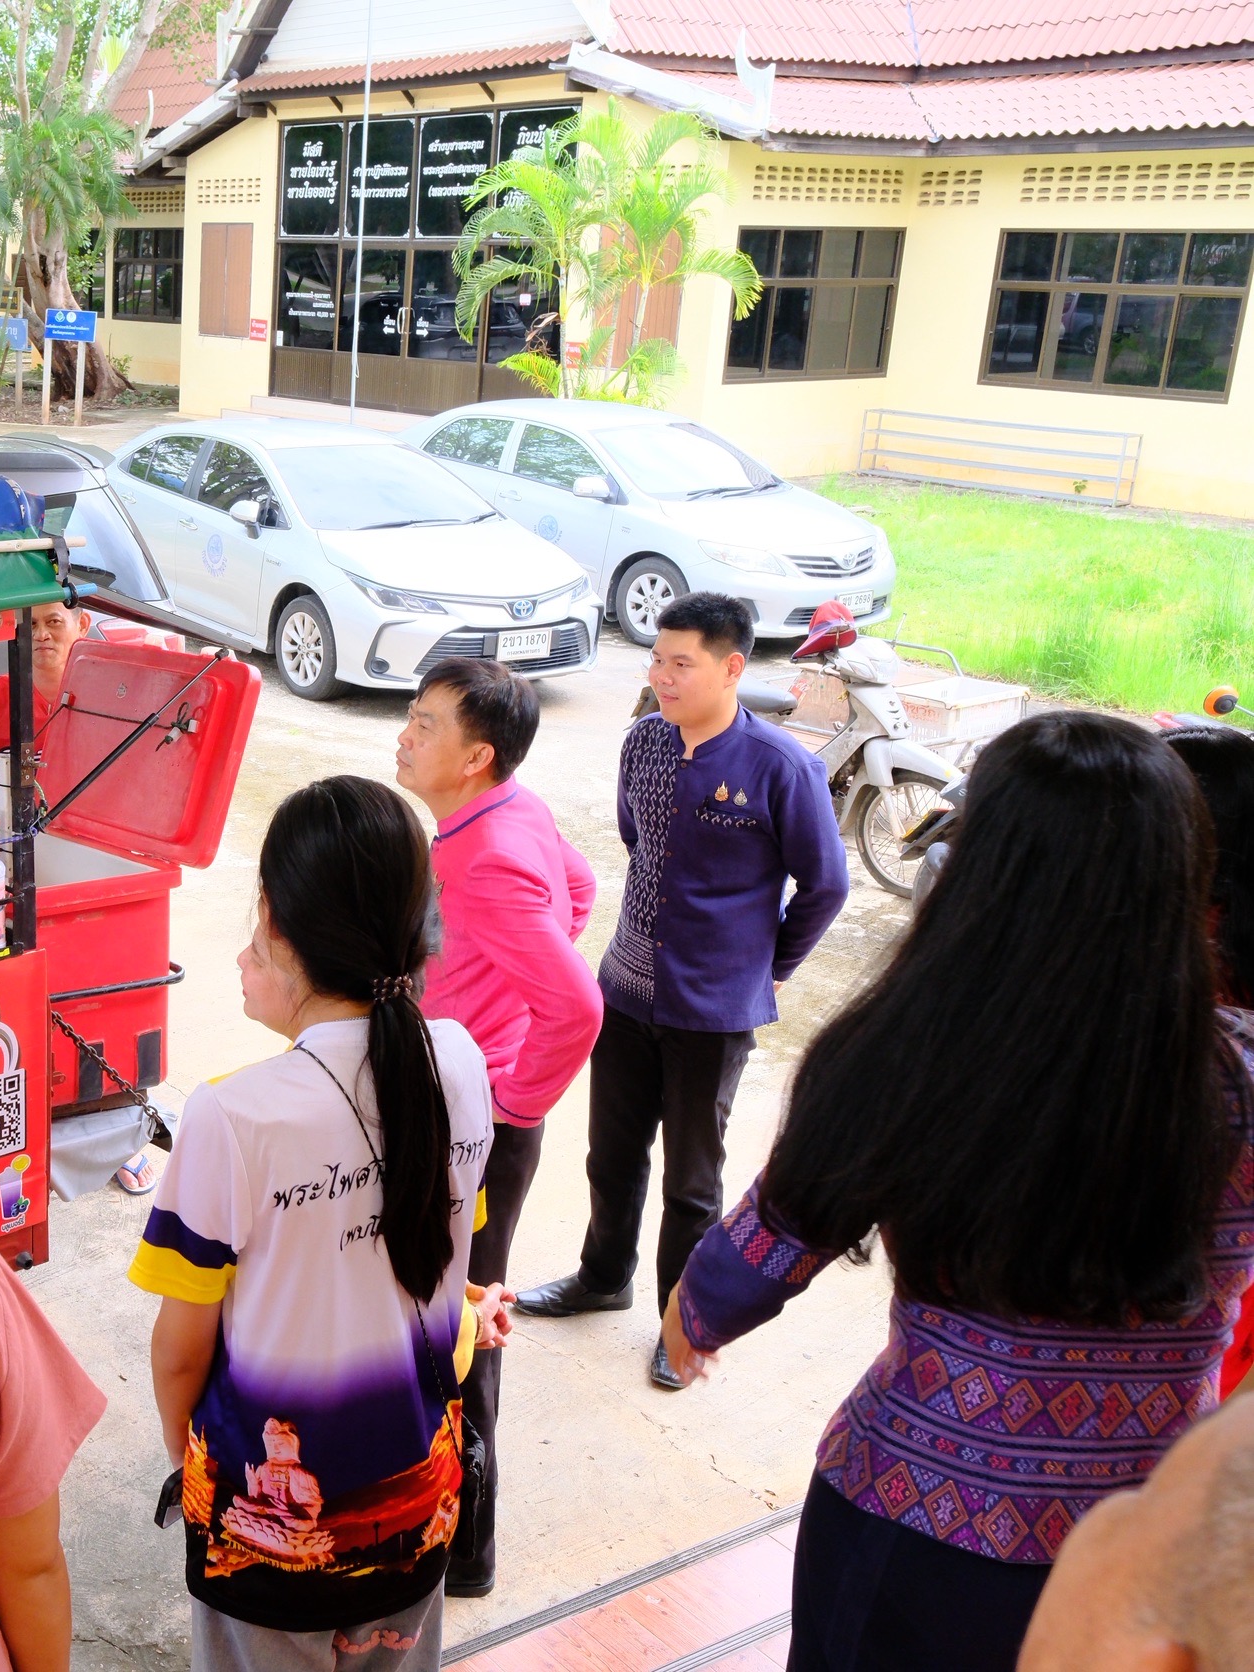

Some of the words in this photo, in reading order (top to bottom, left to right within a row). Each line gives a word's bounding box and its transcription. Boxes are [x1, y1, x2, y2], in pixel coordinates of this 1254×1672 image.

[302, 141, 324, 158] มีสติ
[352, 163, 409, 180] ศาาปฏิบัติธรรม
[351, 182, 410, 199] วิมภาวนาจารย์
[525, 633, 547, 646] 1870
